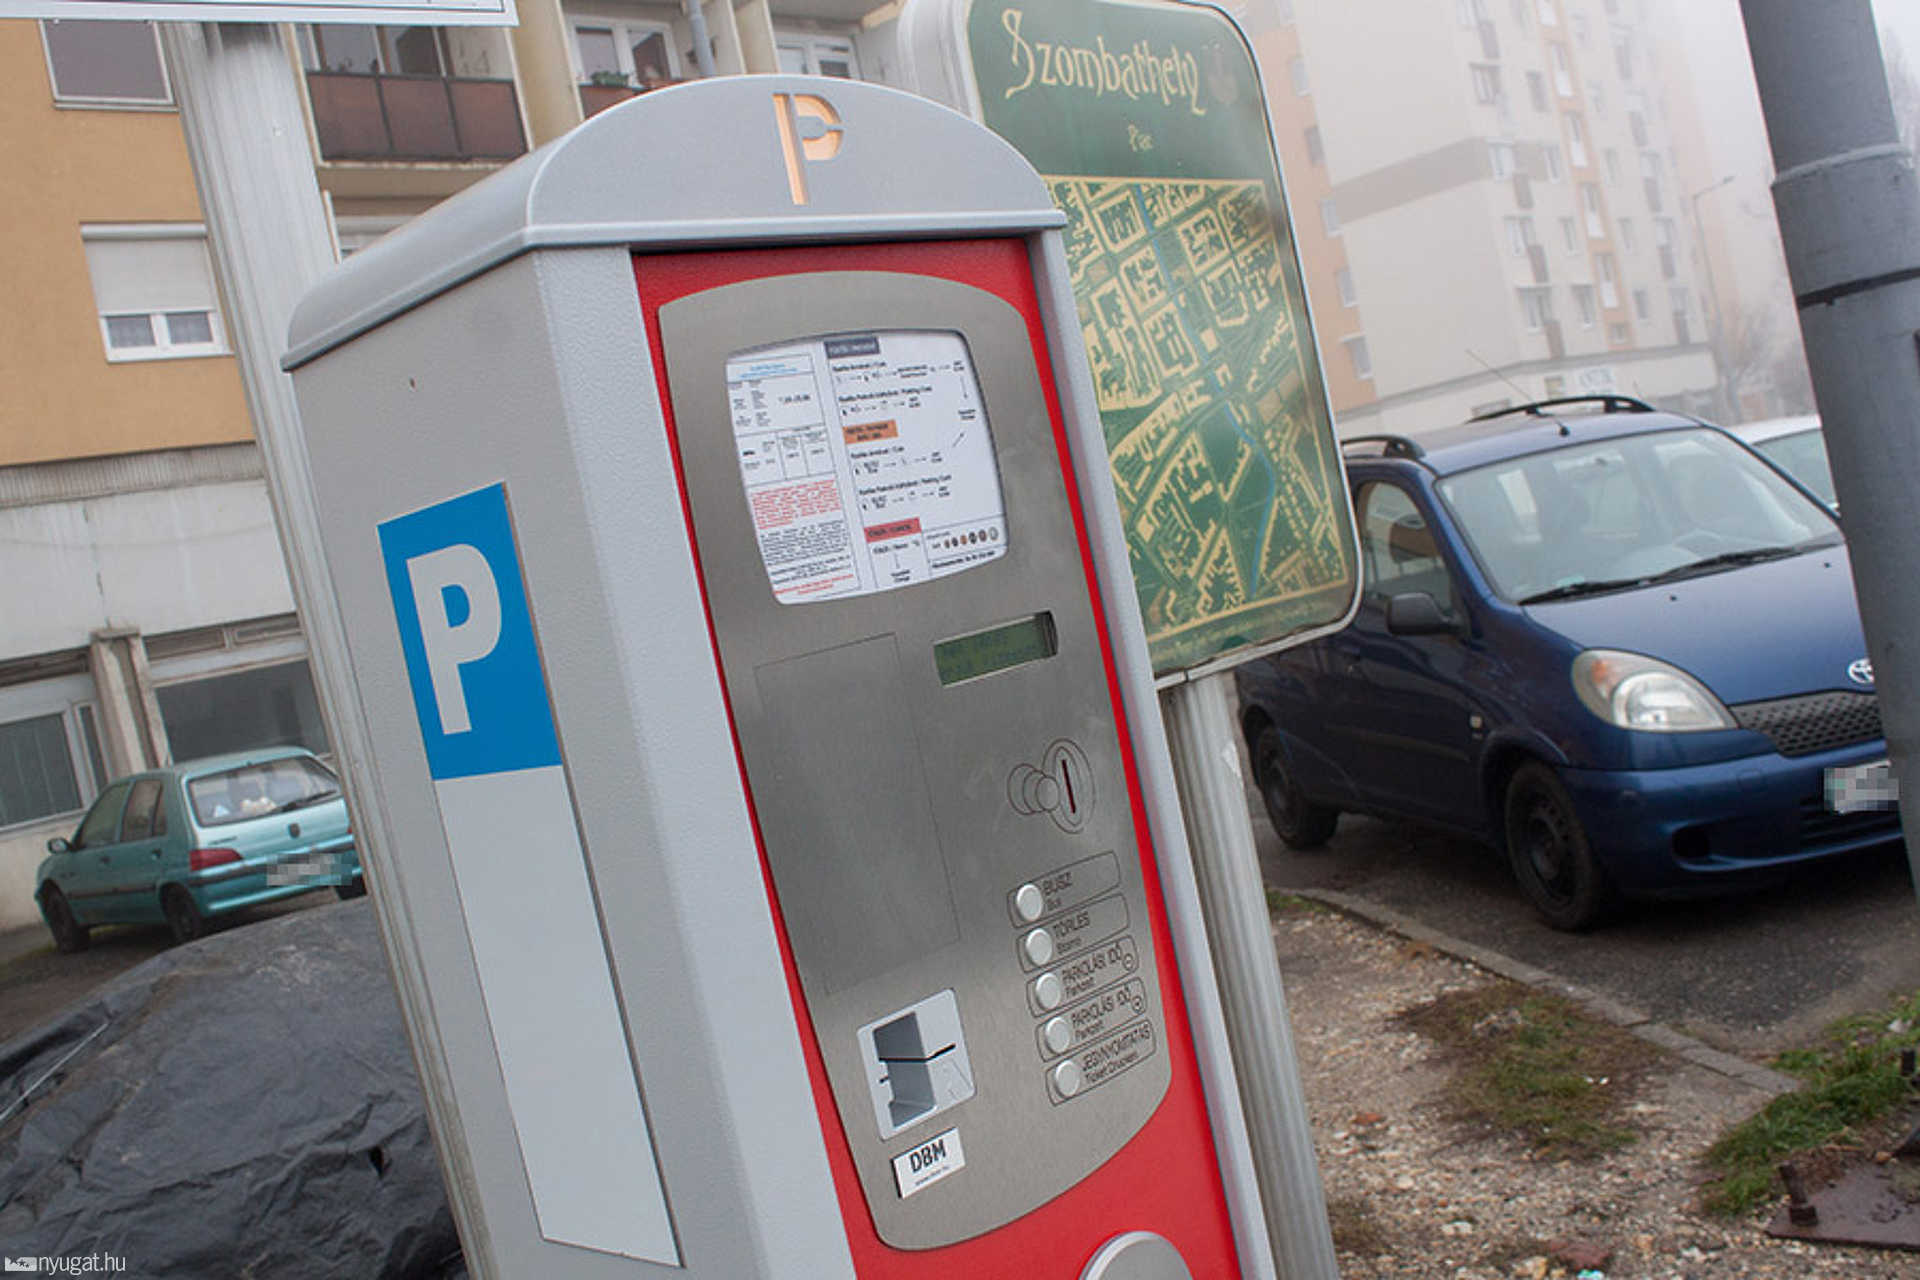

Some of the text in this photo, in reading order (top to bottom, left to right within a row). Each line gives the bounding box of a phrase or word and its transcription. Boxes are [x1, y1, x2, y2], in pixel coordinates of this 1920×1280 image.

[1001, 8, 1206, 115] Szombathely
[772, 92, 844, 206] P
[406, 543, 502, 735] P
[910, 1139, 946, 1173] DBM
